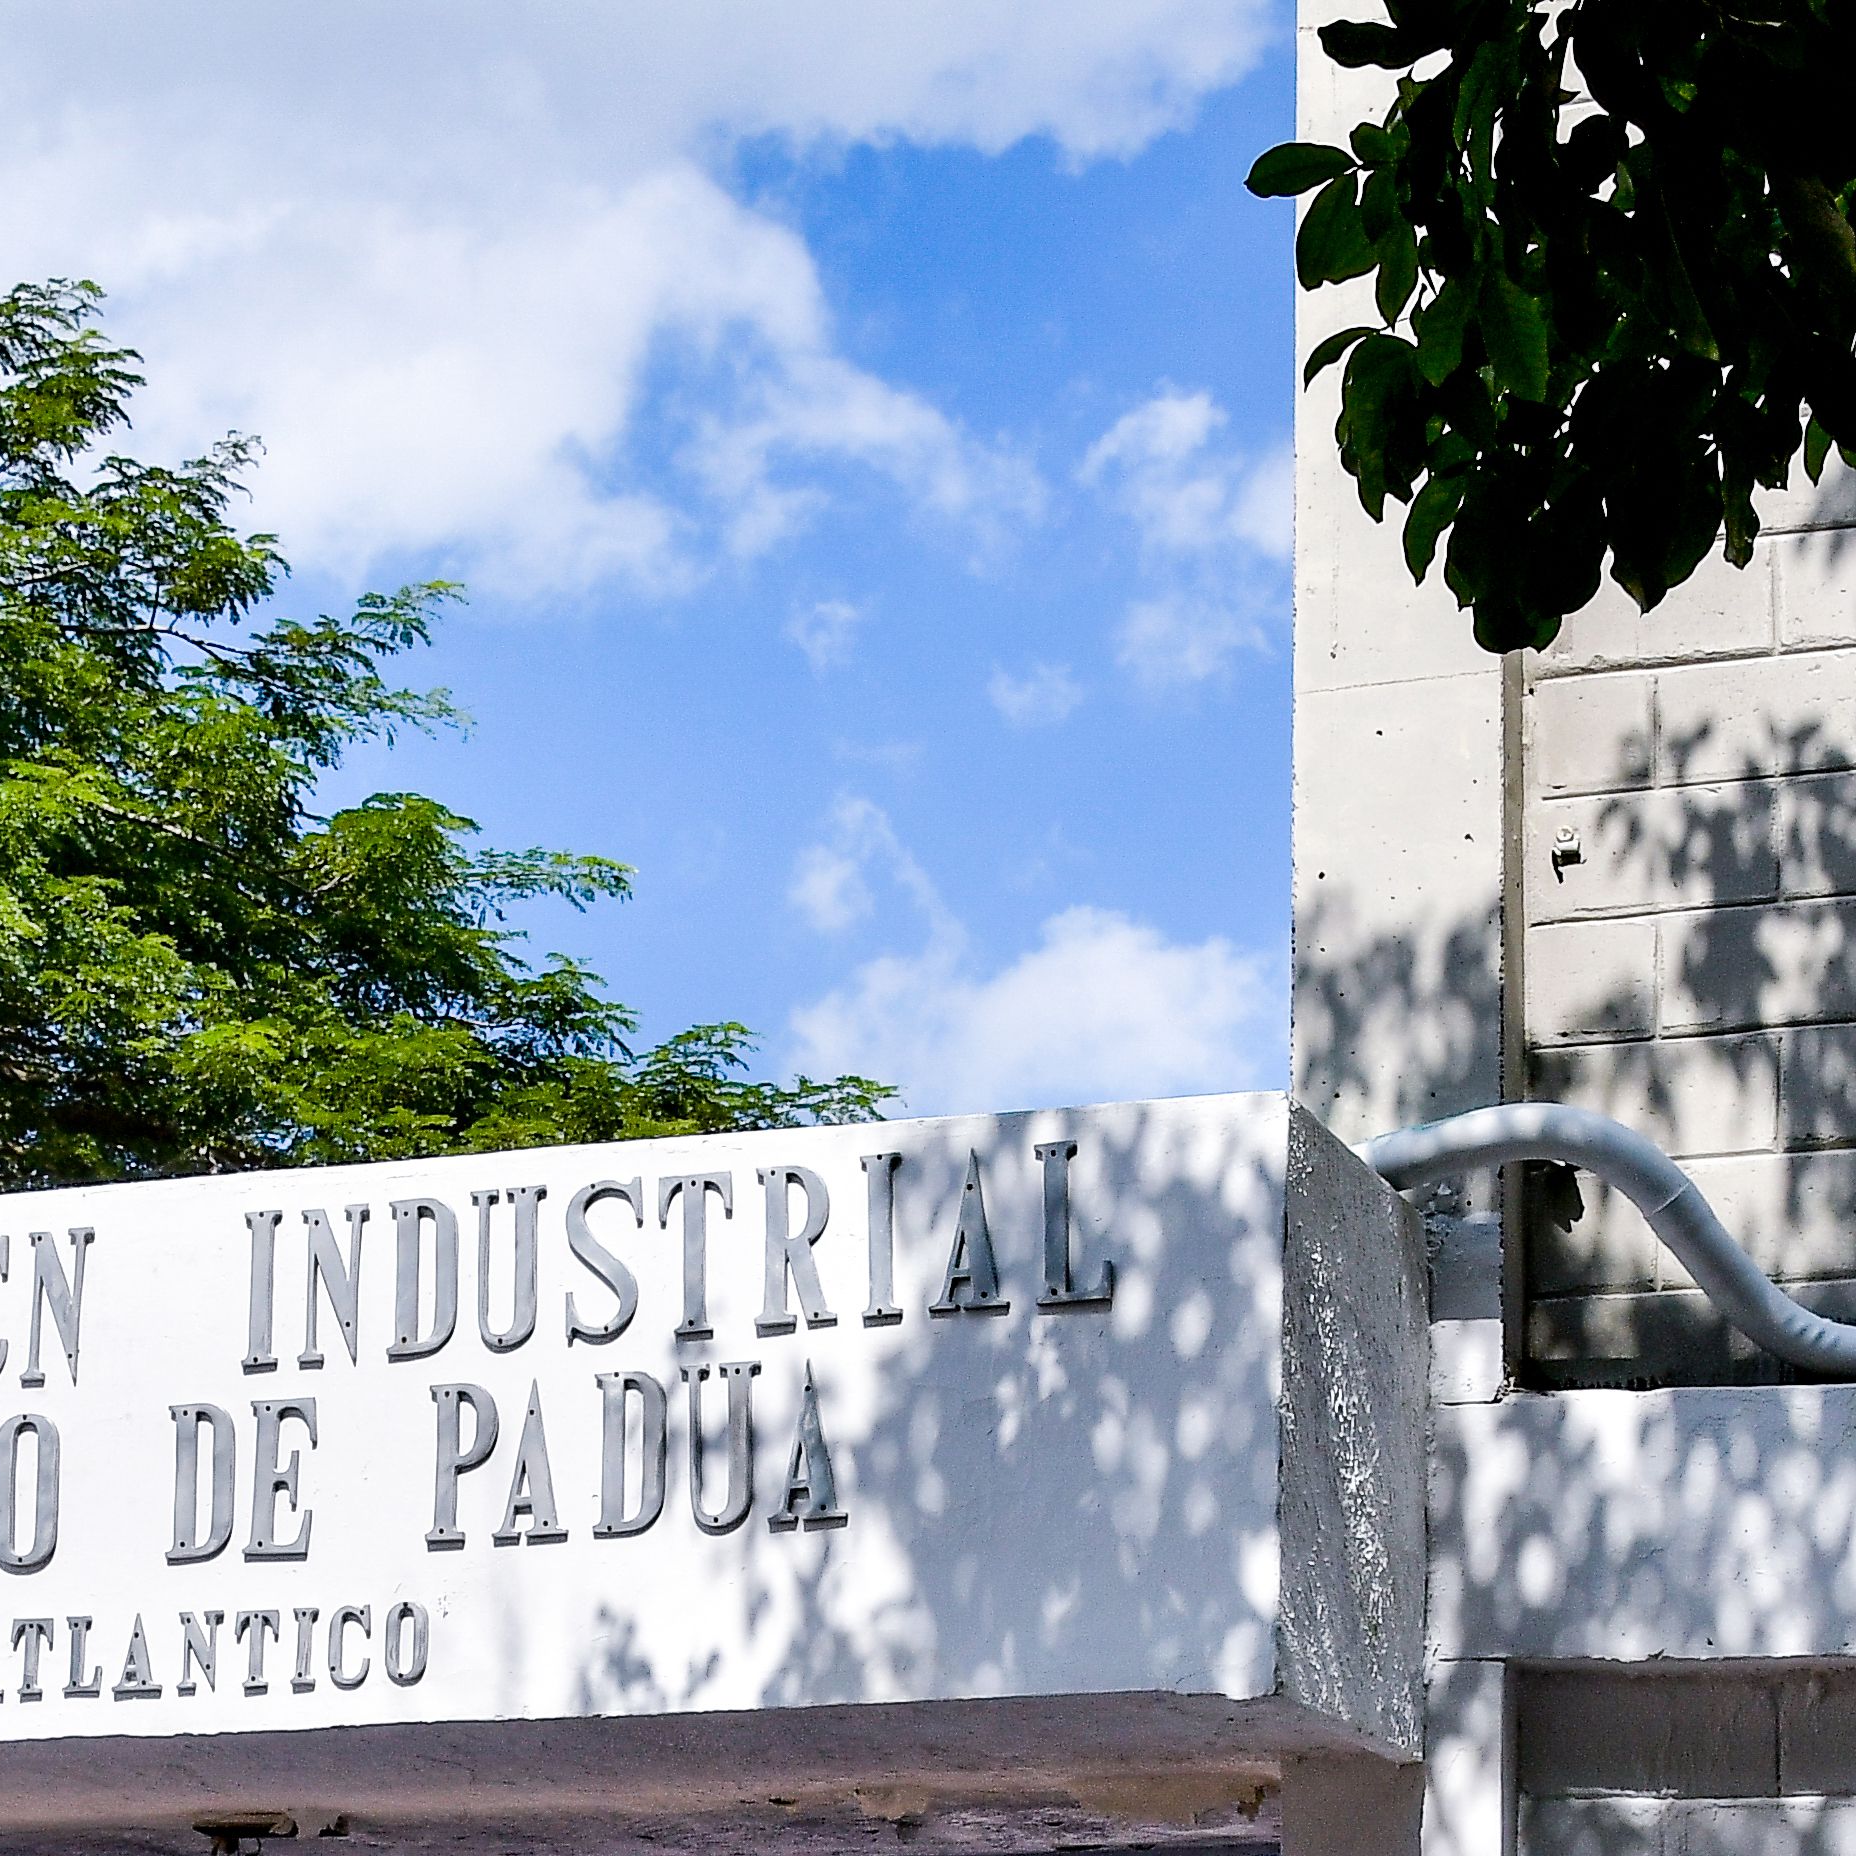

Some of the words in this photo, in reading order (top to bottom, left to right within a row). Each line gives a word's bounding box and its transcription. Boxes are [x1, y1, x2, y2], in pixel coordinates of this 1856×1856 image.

[241, 1139, 1115, 1375] INDUSTRIAL
[164, 1395, 319, 1564] DE
[425, 1358, 850, 1552] PADUA
